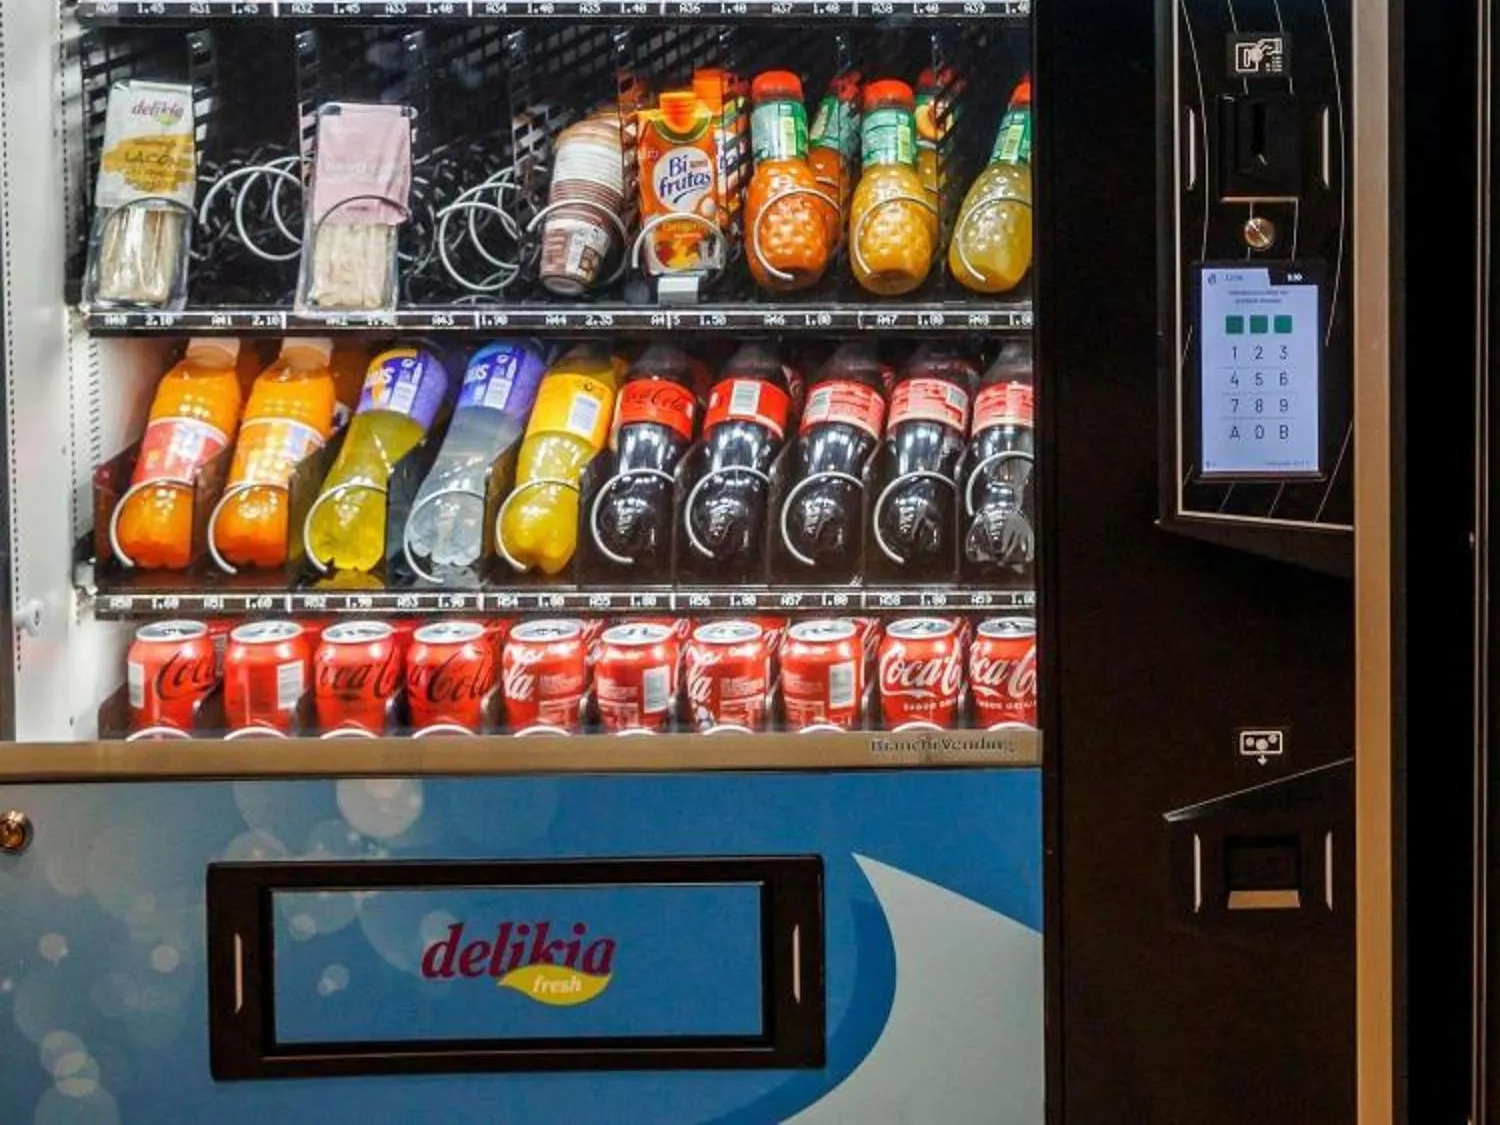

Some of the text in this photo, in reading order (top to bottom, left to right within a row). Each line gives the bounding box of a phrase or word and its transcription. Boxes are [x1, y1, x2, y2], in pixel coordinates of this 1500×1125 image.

[670, 155, 688, 177] Bi
[660, 171, 711, 198] frutas
[1232, 346, 1238, 360] 1
[1254, 346, 1264, 360] 2
[1279, 345, 1288, 360] 3
[1230, 372, 1239, 387] 4
[1255, 372, 1263, 387] 5
[1279, 372, 1288, 386] 6
[1231, 399, 1239, 413] 7
[1255, 398, 1263, 413] 8
[1279, 398, 1289, 413] 9
[1230, 425, 1240, 440] A
[1279, 425, 1289, 440] B
[421, 922, 617, 981] delikia
[532, 973, 582, 995] fresh
